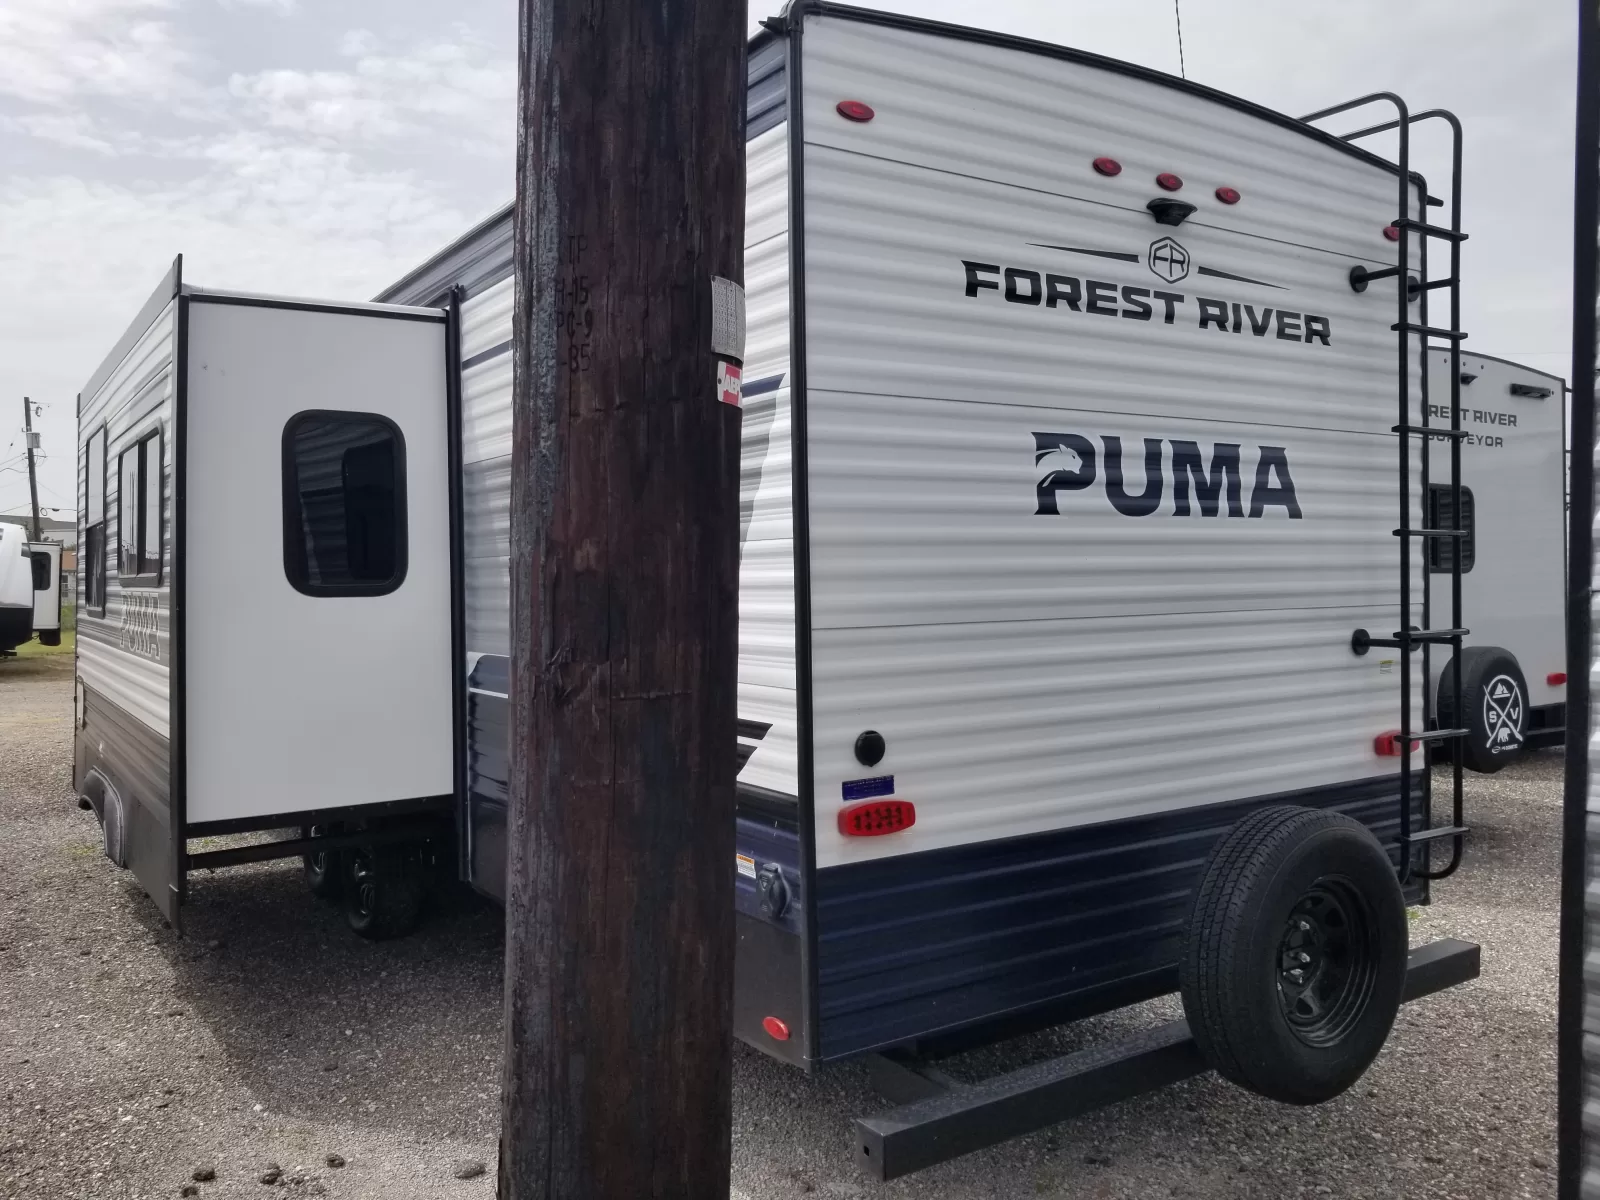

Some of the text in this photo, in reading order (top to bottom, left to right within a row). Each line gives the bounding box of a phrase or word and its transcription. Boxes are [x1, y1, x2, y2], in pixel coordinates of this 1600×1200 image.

[960, 259, 1331, 346] FOREST RIVER
[1428, 404, 1517, 427] RET RIVER
[1428, 434, 1503, 448] EYOR
[1030, 432, 1303, 519] PUMA
[1488, 710, 1498, 723] S
[1509, 707, 1519, 719] V
